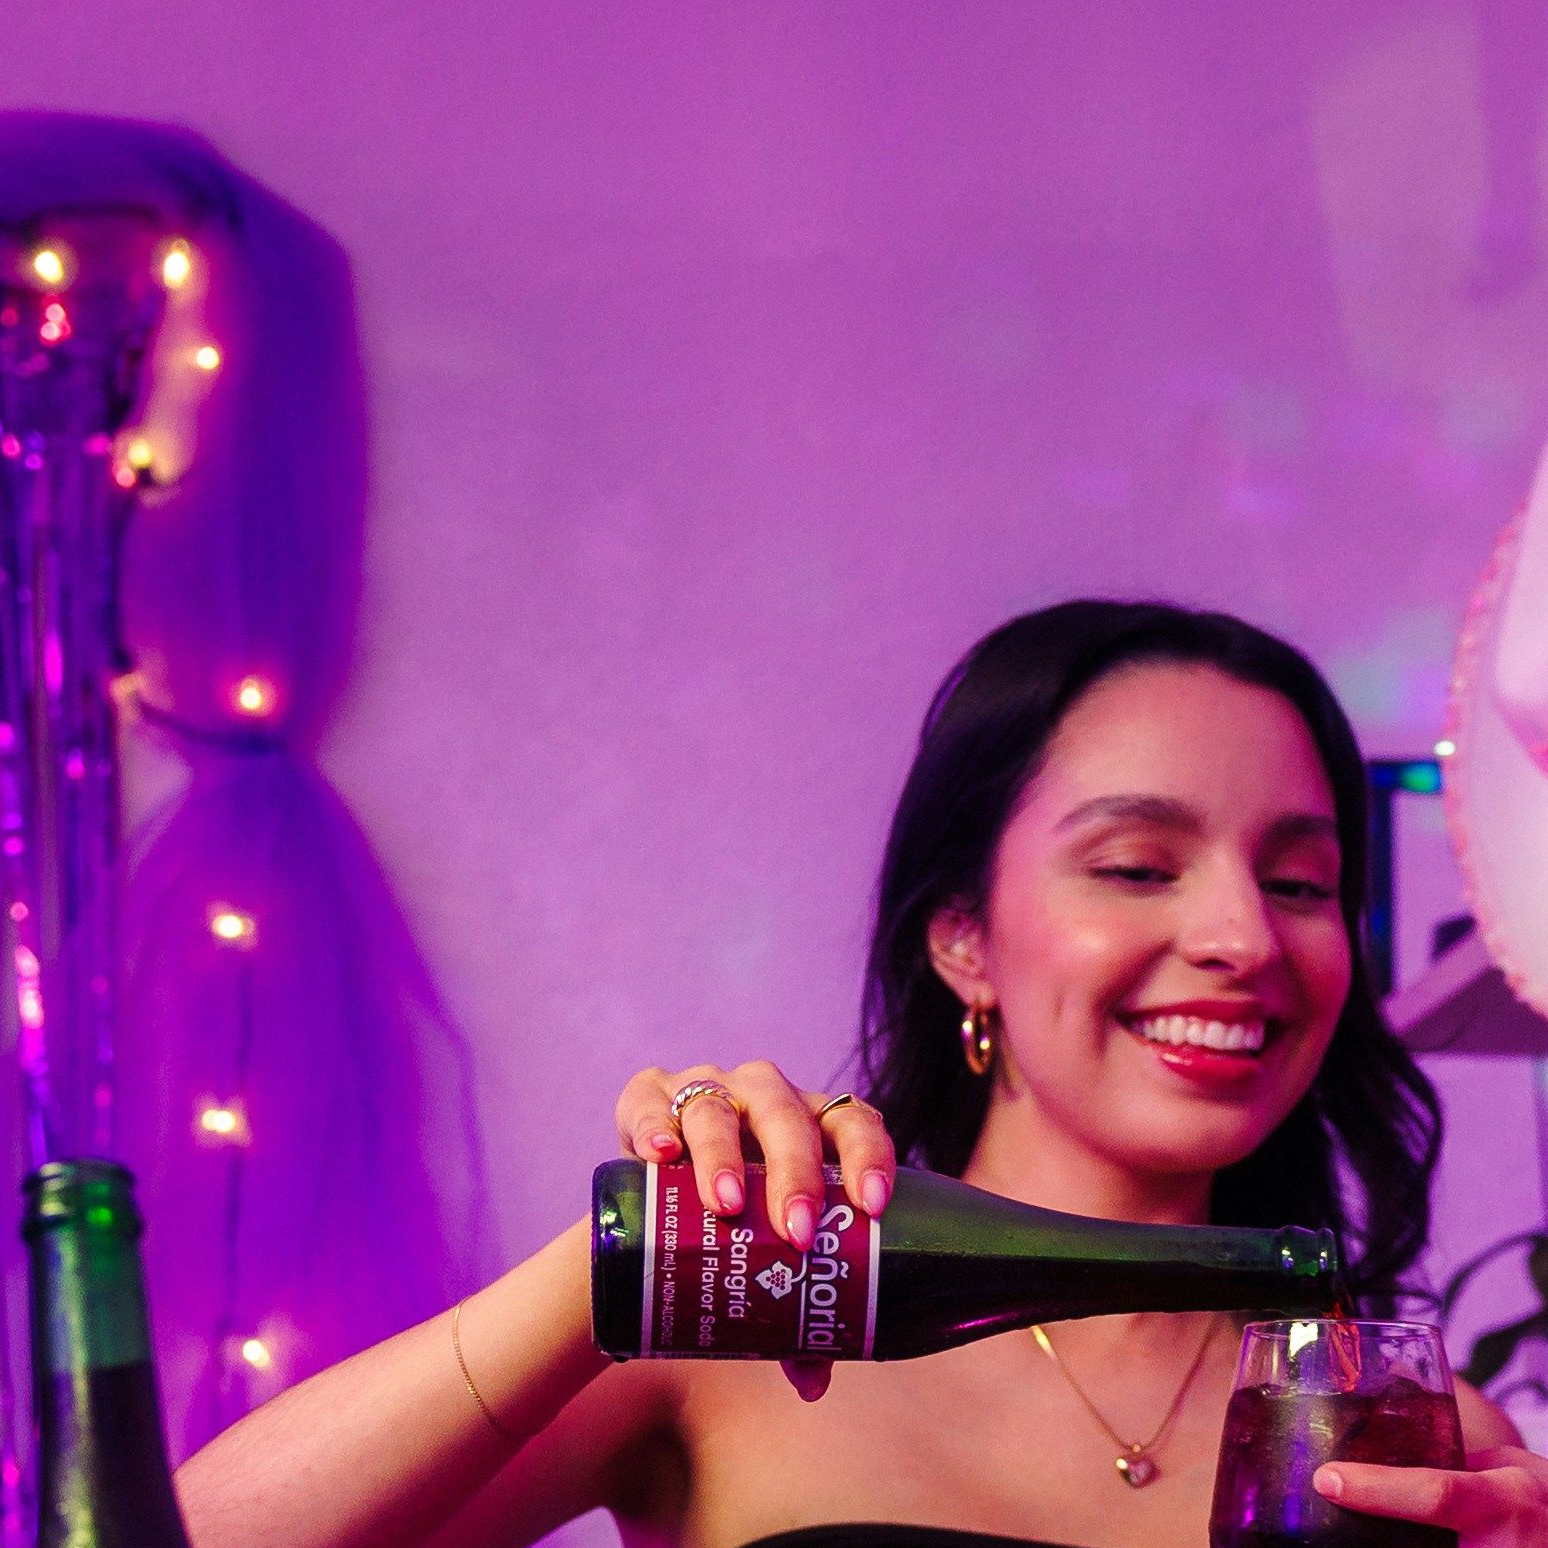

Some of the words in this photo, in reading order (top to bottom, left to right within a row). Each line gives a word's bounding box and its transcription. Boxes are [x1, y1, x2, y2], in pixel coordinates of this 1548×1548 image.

[661, 1230, 677, 1251] (330
[664, 1215, 678, 1229] OZ
[702, 1208, 720, 1250] tural
[700, 1257, 719, 1311] Flavor
[724, 1227, 754, 1318] Sangría
